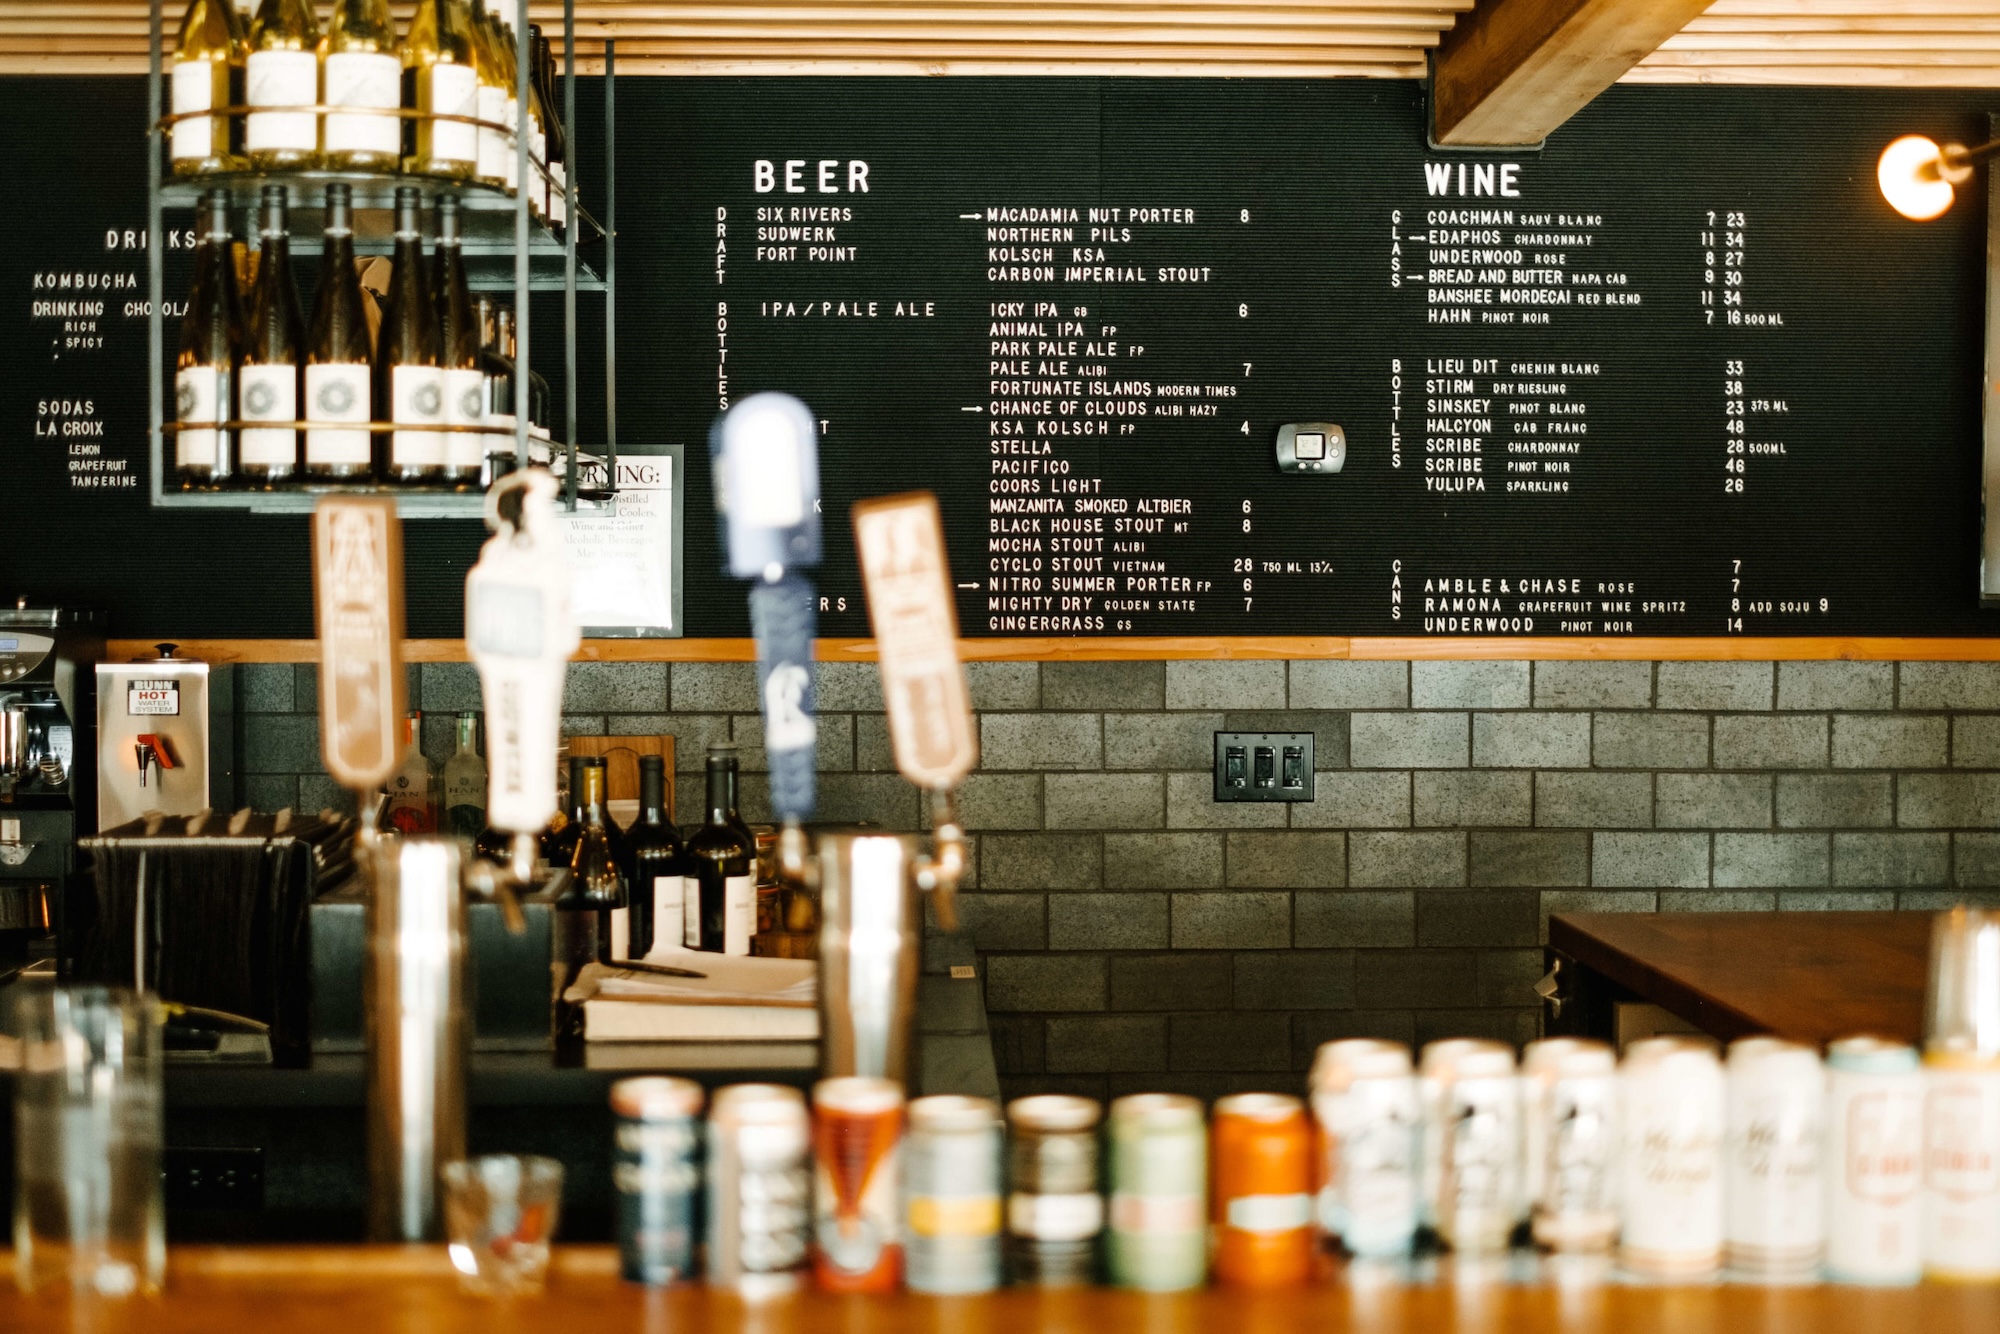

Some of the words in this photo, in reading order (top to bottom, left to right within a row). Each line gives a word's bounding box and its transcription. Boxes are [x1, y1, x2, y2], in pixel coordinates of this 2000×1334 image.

[755, 160, 869, 193] BEER
[1424, 163, 1520, 197] WINE
[757, 207, 783, 223] SIX
[791, 207, 852, 222] RIVERS
[987, 207, 1078, 223] MACADAMIA
[1089, 208, 1121, 224] NUT
[1130, 208, 1194, 224] PORTER
[1427, 210, 1513, 225] COACHMAN
[1520, 214, 1551, 226] SAUV
[1558, 215, 1602, 226] BLANC
[1727, 212, 1745, 228] 23
[106, 230, 197, 249] DRIKS
[758, 227, 835, 242] SUDWERK
[987, 227, 1073, 242] NORTHERN
[1091, 227, 1130, 242] PILS
[1429, 230, 1501, 245] EDAPHOS
[1514, 234, 1592, 245] CHARDONNAY
[1725, 232, 1744, 247] 34
[757, 247, 797, 261] FORT
[809, 247, 857, 262] POINT
[989, 246, 1052, 263] KOLSCH
[1073, 248, 1105, 263] KSA
[1429, 249, 1522, 265] UNDERWOOD
[1535, 254, 1565, 265] ROSE
[1725, 251, 1744, 266] 27
[34, 273, 137, 289] KOMBUCHA
[988, 266, 1054, 282] CARBON
[1064, 267, 1146, 282] IMPERIAL
[1158, 267, 1211, 282] STOUT
[1429, 269, 1474, 284] BREAD
[1478, 269, 1507, 284] AND
[1512, 269, 1563, 284] BUTTER
[1572, 273, 1601, 285] NAPA
[1606, 273, 1627, 285] CAB
[1725, 271, 1742, 286] 30
[1428, 288, 1493, 304] BANSHEE
[1500, 288, 1570, 304] MORDECAI
[1578, 293, 1600, 305] RED
[1606, 293, 1641, 305] BLEND
[1723, 290, 1741, 306] 34
[33, 301, 104, 317] DRINKING
[895, 302, 935, 316] ALE
[991, 302, 1024, 317] ICKY
[1035, 302, 1058, 317] IPA
[1428, 308, 1471, 323] HAHN
[1482, 312, 1514, 323] PINOT
[1523, 313, 1549, 324] NOIR
[65, 321, 96, 332] RICH
[989, 322, 1047, 337] ANIMAL
[1058, 321, 1083, 337] IPA
[66, 337, 103, 348] SPICY
[991, 341, 1030, 356] PARK
[1039, 341, 1077, 356] PALE
[1086, 342, 1117, 357] ALE
[991, 360, 1030, 375] PALE
[1038, 361, 1068, 376] ALE
[1078, 365, 1106, 377] ALIBI
[1427, 359, 1464, 374] LIEU
[1473, 359, 1498, 373] DIT
[1511, 363, 1555, 374] CHENIN
[1561, 363, 1599, 375] BLANC
[991, 381, 1082, 396] FORTUNATE
[1089, 381, 1152, 397] ISLANDS
[1157, 385, 1200, 396] MODERN
[1205, 386, 1236, 397] TIMES
[1426, 379, 1473, 394] STIRM
[1493, 383, 1514, 394] DRY
[1518, 383, 1566, 394] RIESLING
[38, 401, 94, 415] SODAS
[990, 400, 1052, 416] CHANCE
[1060, 401, 1078, 415] OF
[1085, 401, 1147, 416] CLOUDS
[1155, 405, 1182, 416] ALIBI
[1190, 405, 1217, 416] HAZY
[1427, 399, 1490, 413] SINSKEY
[1509, 403, 1540, 414] PINOT
[1550, 403, 1585, 414] BLANC
[1726, 400, 1744, 415] 23
[36, 420, 57, 436] LA
[63, 421, 103, 436] CROIX
[991, 420, 1024, 436] KSA
[1037, 421, 1107, 435] KOLSCH
[1427, 418, 1491, 433] HALCYON
[1514, 422, 1537, 433] CAB
[1548, 422, 1587, 434] FRANC
[69, 444, 100, 455] LEMON
[991, 440, 1051, 455] STELLA
[1426, 438, 1482, 453] SCRIBE
[1508, 442, 1580, 453] CHARDONNAY
[1727, 439, 1744, 454] 28
[69, 460, 127, 471] GRAPEFRUIT
[992, 460, 1069, 474] PACIFICO
[1425, 458, 1482, 472] SCRIBE
[1508, 461, 1537, 472] PINOT
[1545, 462, 1570, 473] NOIR
[71, 475, 136, 487] TANGERINE
[990, 479, 1040, 493] COORS
[1052, 478, 1101, 493] LIGHT
[1425, 477, 1485, 492] YULUPA
[1507, 481, 1568, 492] SPARKLING
[990, 498, 1064, 513] MANZANITA
[1075, 499, 1128, 514] SMOKED
[1137, 499, 1191, 514] ALTBIER
[571, 520, 595, 531] Wine
[990, 518, 1041, 533] BLACK
[1051, 518, 1103, 533] HOUSE
[1115, 518, 1164, 533] STOUT
[989, 538, 1042, 552] MOCHA
[1051, 538, 1103, 552] STOUT
[1114, 542, 1144, 552] ALIBI
[990, 557, 1042, 572] CYCLO
[1052, 557, 1103, 572] STOUT
[1113, 561, 1165, 572] VIETNAM
[1234, 558, 1252, 572] 28
[990, 577, 1041, 591] NITRO
[1052, 577, 1115, 592] SUMMER
[1127, 577, 1191, 591] PORTER
[1424, 578, 1491, 593] AMBLE
[1519, 579, 1580, 593] CHASE
[1599, 583, 1634, 593] ROSE
[989, 596, 1052, 611] MIGHTY
[1062, 596, 1092, 611] DRY
[1104, 600, 1149, 611] GOLDEN
[1158, 600, 1195, 611] STATE
[1425, 597, 1501, 612] RAMONA
[1519, 601, 1592, 612] GRAPEFRUIT
[1602, 602, 1631, 612] WINE
[1642, 601, 1685, 612] SPRITZ
[1749, 602, 1772, 612] ADD
[1780, 602, 1809, 612] SOJU
[990, 616, 1104, 630] GINGERGRASS
[1425, 617, 1533, 632] UNDERWOOD
[1561, 621, 1592, 632] PINOT
[1604, 621, 1632, 632] NOIR
[133, 681, 173, 690] BUNN
[139, 691, 168, 700] HOT
